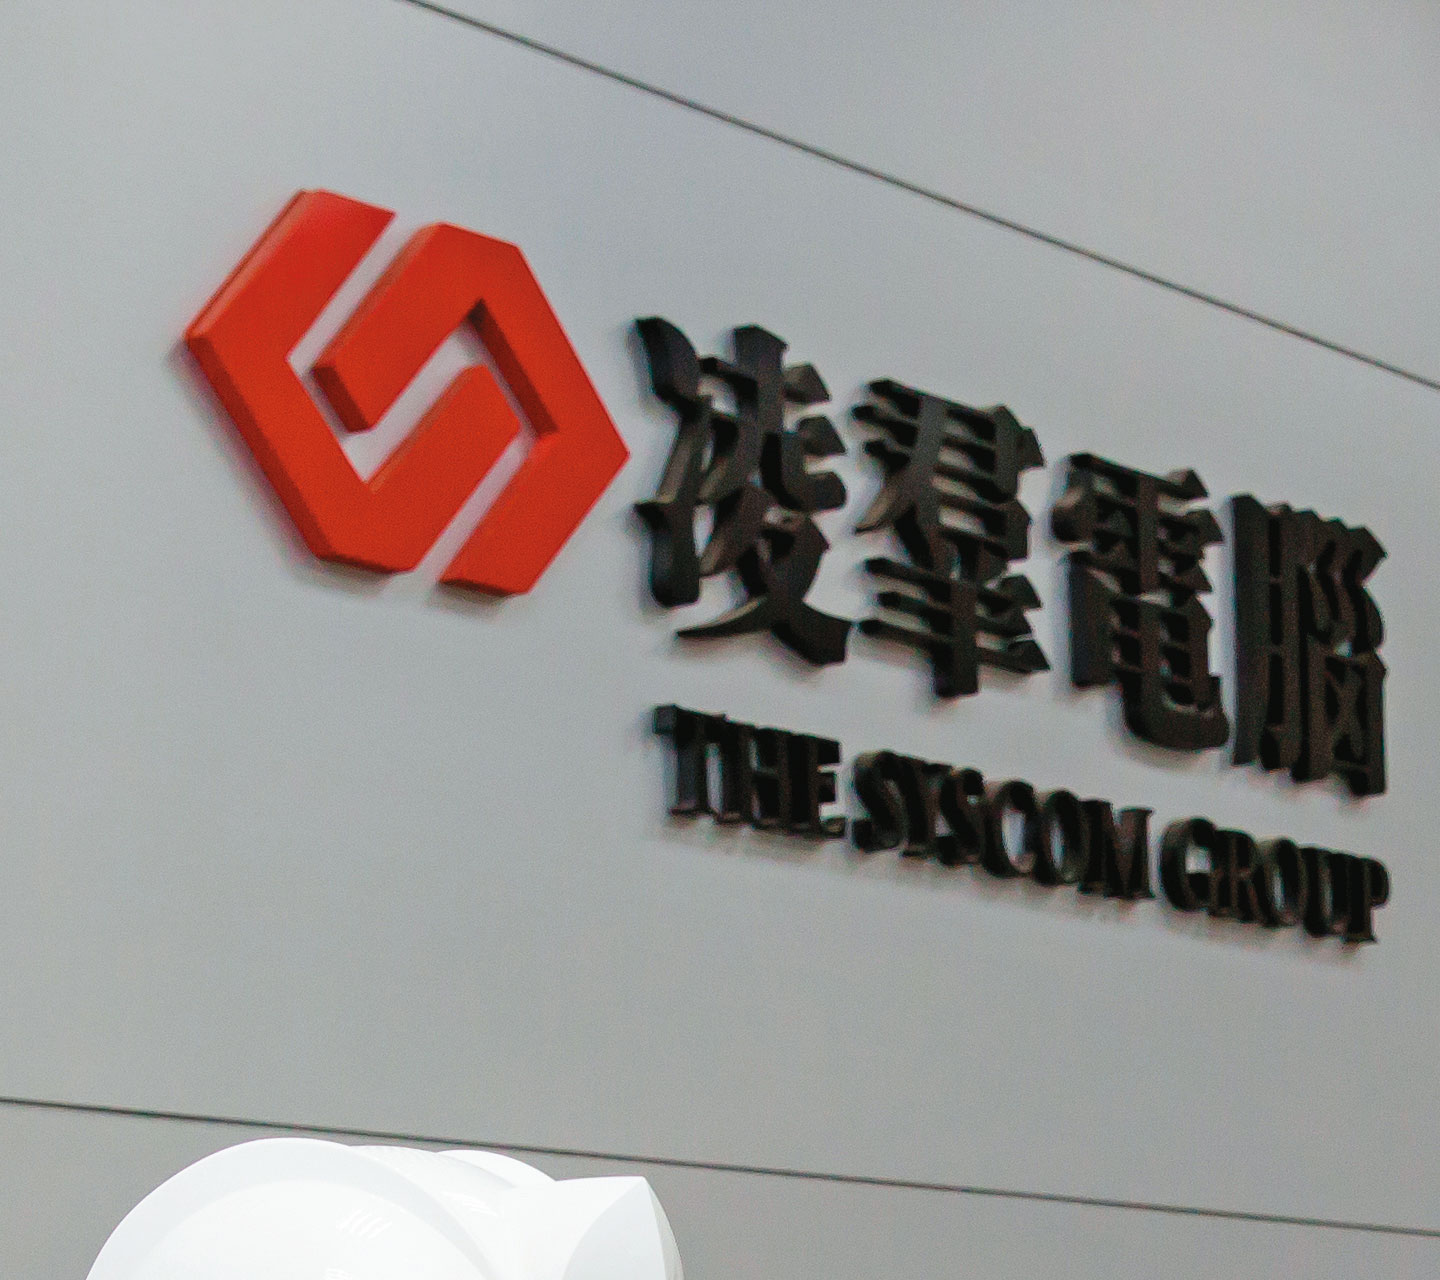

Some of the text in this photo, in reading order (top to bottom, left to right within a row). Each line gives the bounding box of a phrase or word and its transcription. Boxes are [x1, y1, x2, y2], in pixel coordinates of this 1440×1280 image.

[653, 703, 1390, 943] THE SYSCOM GROUP
